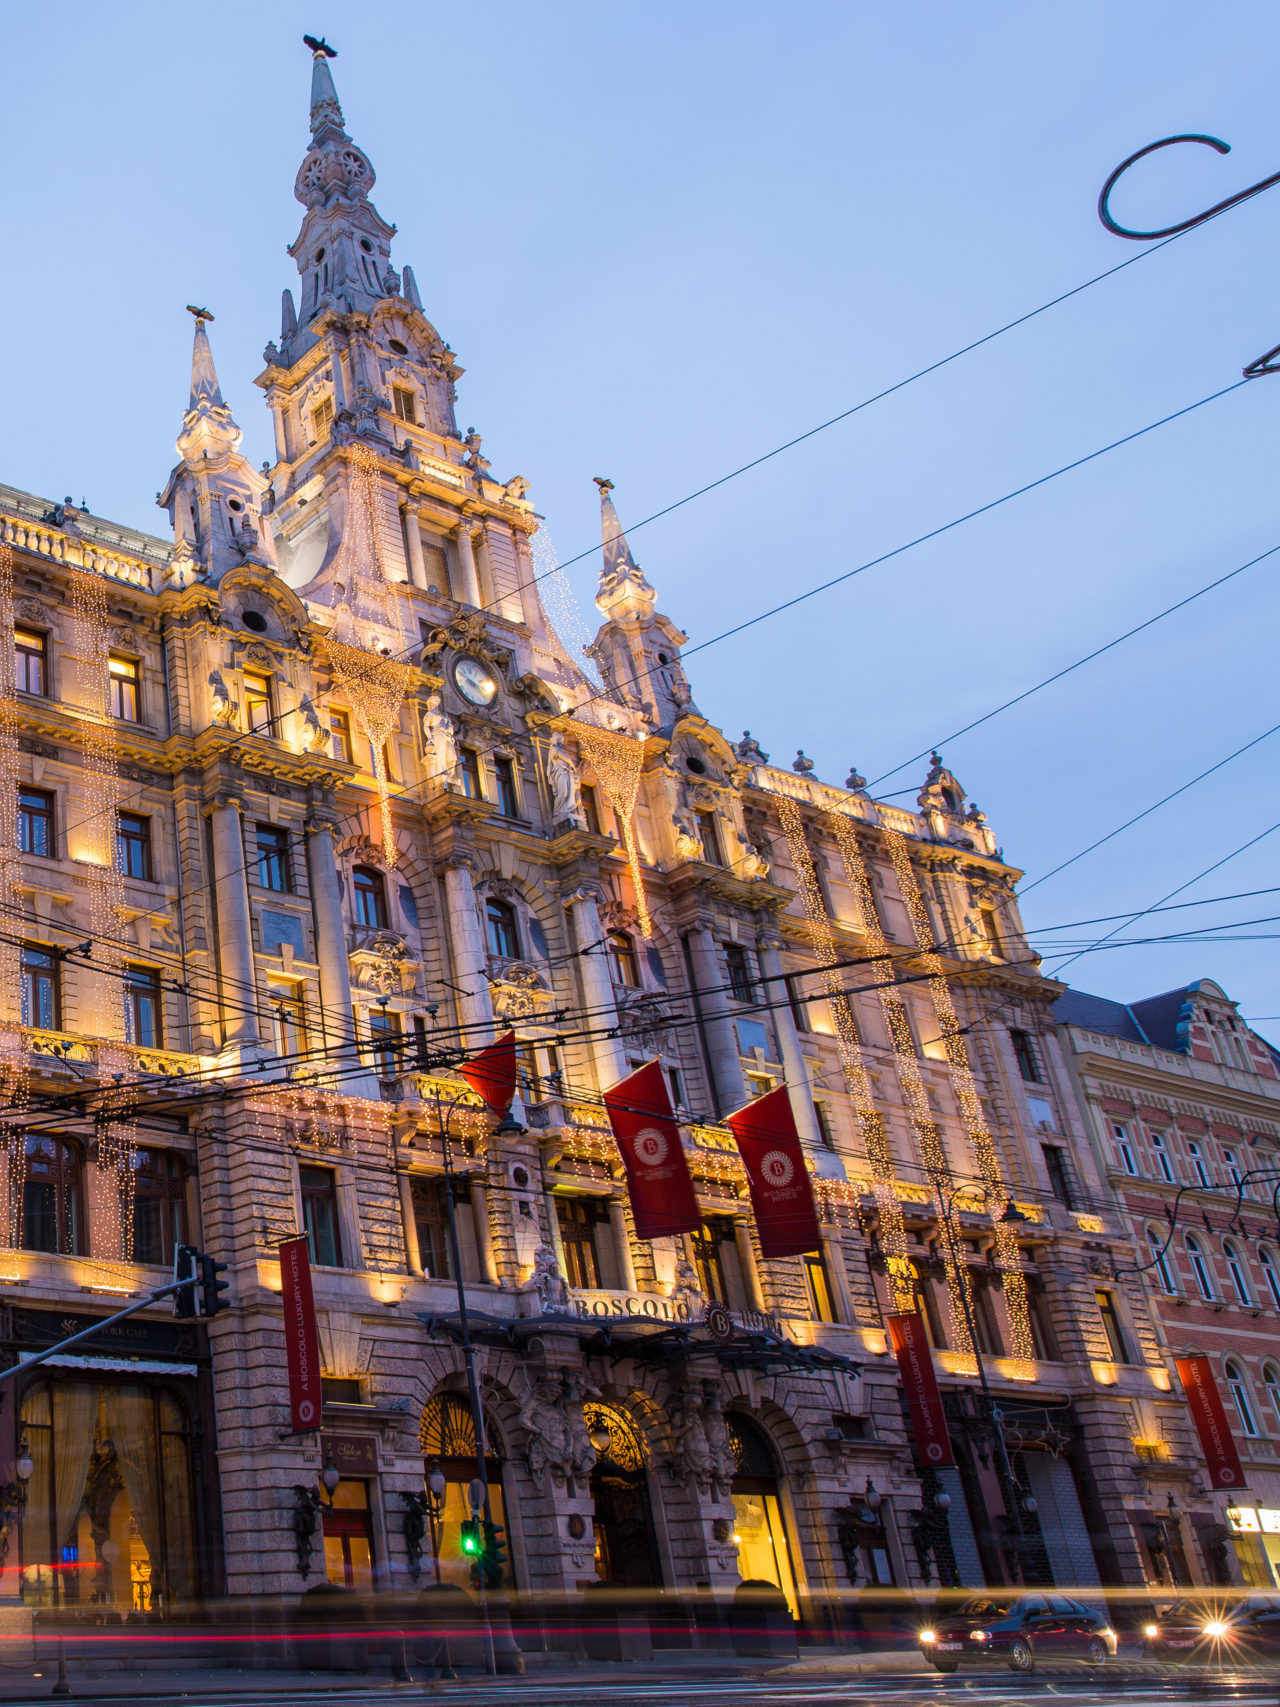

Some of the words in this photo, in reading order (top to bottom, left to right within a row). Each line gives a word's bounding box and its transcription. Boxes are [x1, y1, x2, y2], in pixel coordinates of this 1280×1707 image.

[290, 1247, 299, 1282] HOTEL
[293, 1285, 305, 1327] LUXURY
[575, 1297, 691, 1320] BOSCOLO
[716, 1316, 727, 1331] B
[903, 1319, 914, 1348] HOTEL
[298, 1330, 308, 1382] BOSCOLO
[908, 1351, 922, 1383] LUXURY
[302, 1383, 309, 1391] A
[1190, 1362, 1202, 1386] HOTEL
[1207, 1418, 1225, 1455] BOSCOLO
